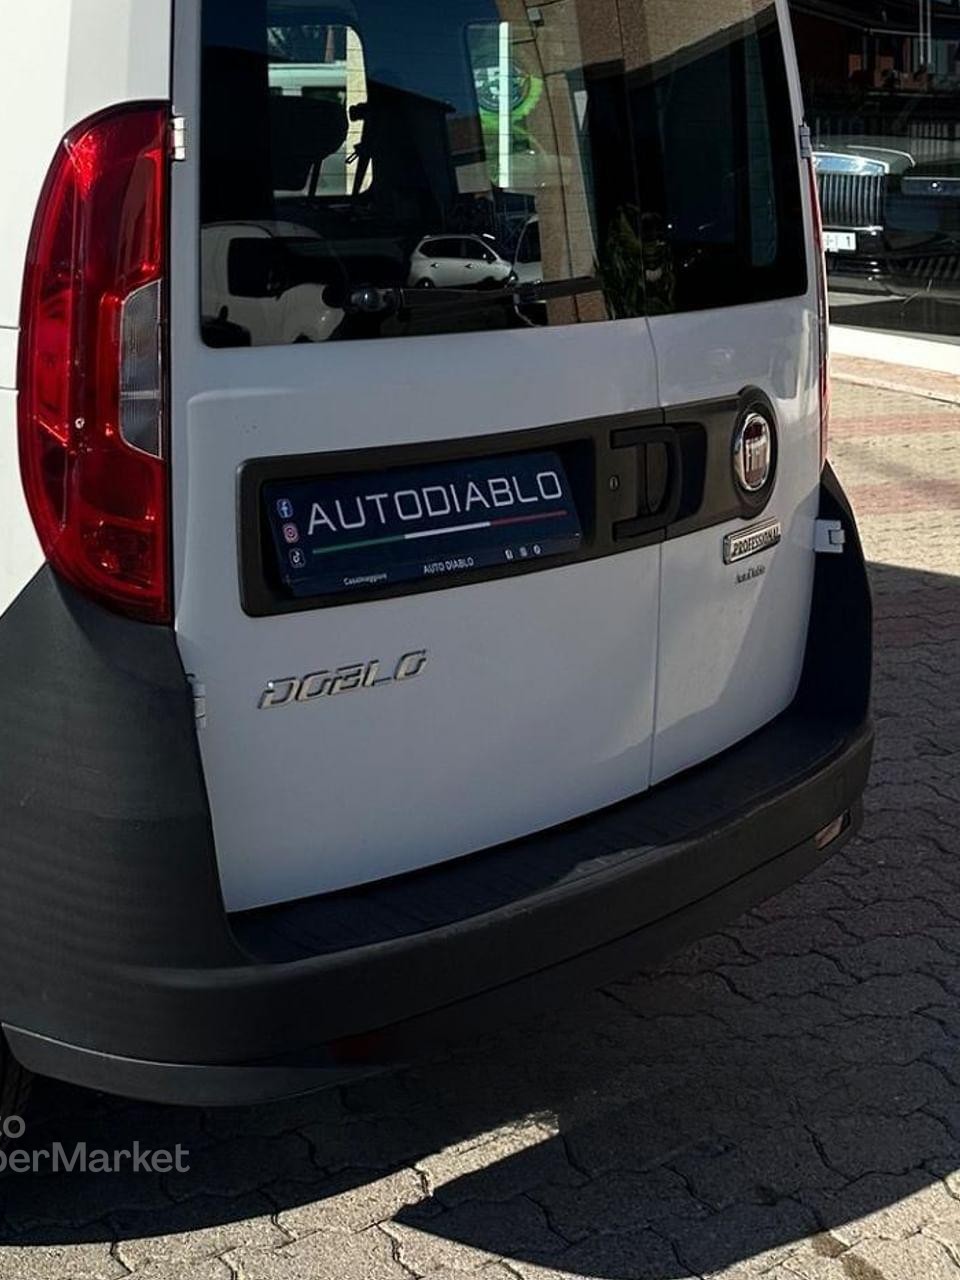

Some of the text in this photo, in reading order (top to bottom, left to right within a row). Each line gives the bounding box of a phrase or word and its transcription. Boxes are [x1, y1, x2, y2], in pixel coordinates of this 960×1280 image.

[307, 471, 563, 536] AUTODIABLO
[424, 556, 474, 575] AUTO DIABLO
[257, 648, 428, 710] DOBLO
